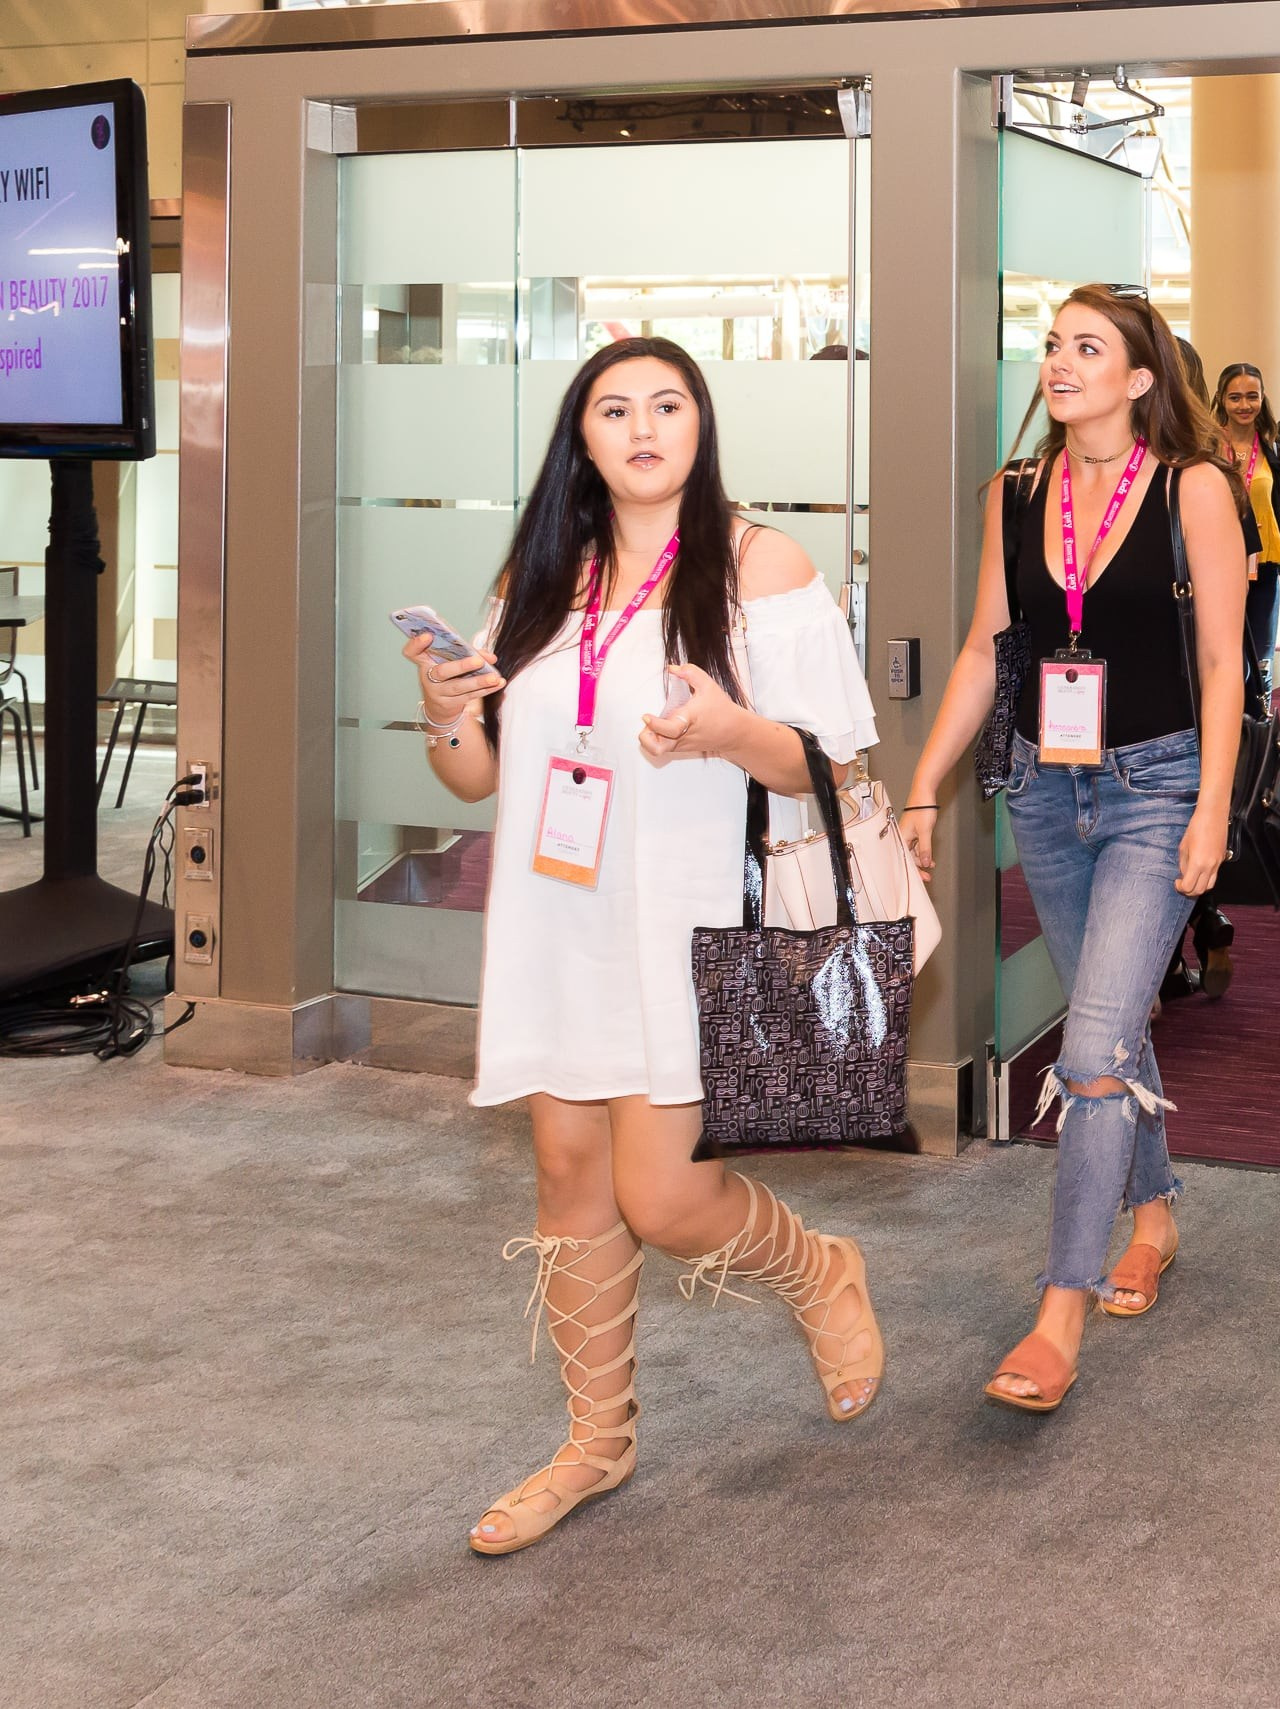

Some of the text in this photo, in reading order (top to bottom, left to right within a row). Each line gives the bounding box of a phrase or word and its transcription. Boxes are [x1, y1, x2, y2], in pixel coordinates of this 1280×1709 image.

[14, 166, 50, 202] WIFI
[10, 278, 68, 310] BEAUTY
[72, 276, 109, 308] 2017
